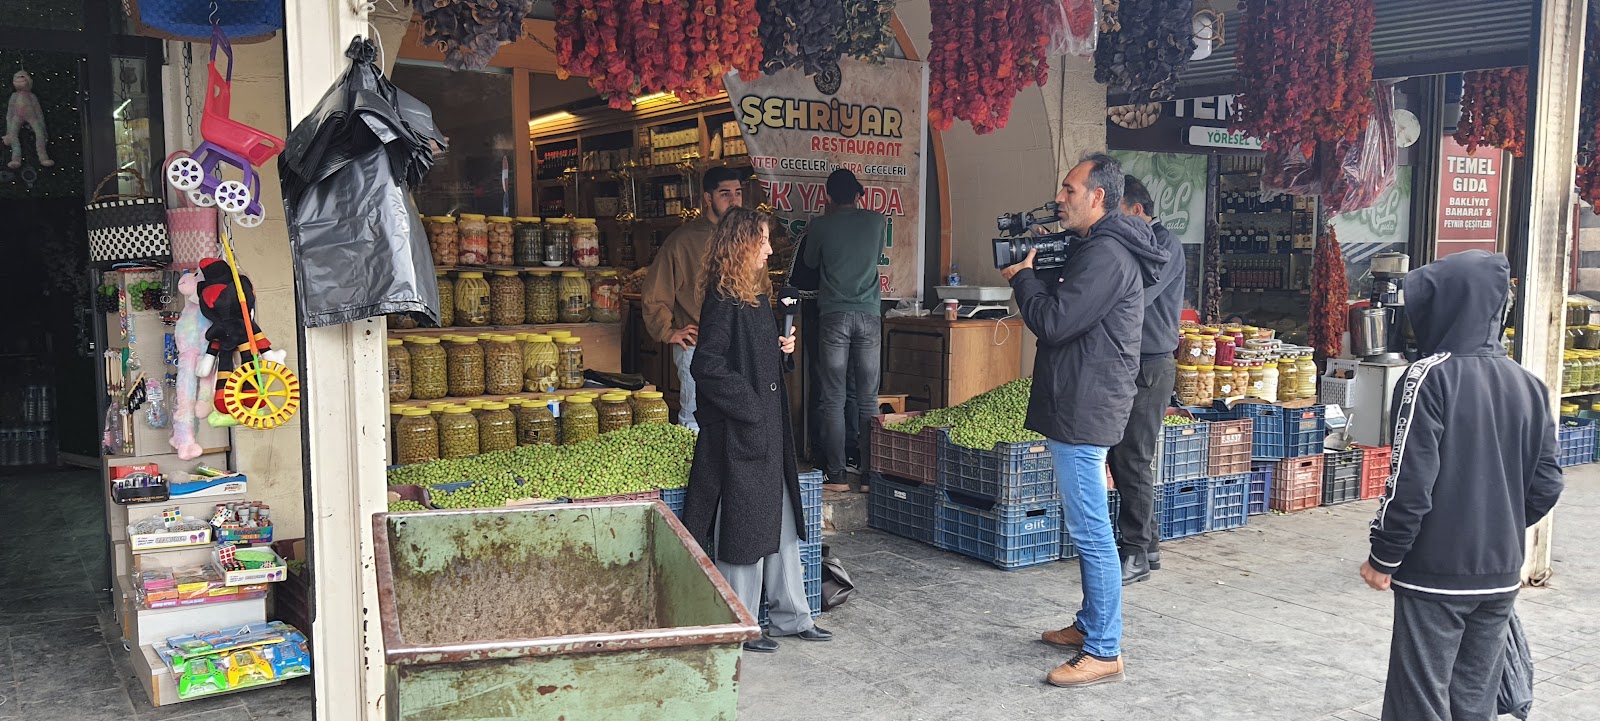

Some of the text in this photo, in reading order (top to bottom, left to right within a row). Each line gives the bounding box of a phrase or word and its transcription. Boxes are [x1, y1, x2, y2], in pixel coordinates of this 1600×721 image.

[811, 135, 902, 157] RESTAURANT
[1207, 129, 1249, 146] YÖRESEL
[780, 158, 829, 172] GECELERİ
[864, 165, 906, 176] GECELERİ
[1447, 156, 1496, 175] TEMEL
[1452, 177, 1488, 193] GIDA
[1449, 196, 1490, 207] BAKLİYAT
[1445, 207, 1492, 217] BAHARAT &
[1443, 218, 1492, 230] PEYNİR ÇEŞİTLERİ
[1402, 381, 1417, 404] DIOR
[1391, 417, 1407, 466] CHRISTIAN
[1024, 519, 1046, 531] elit
